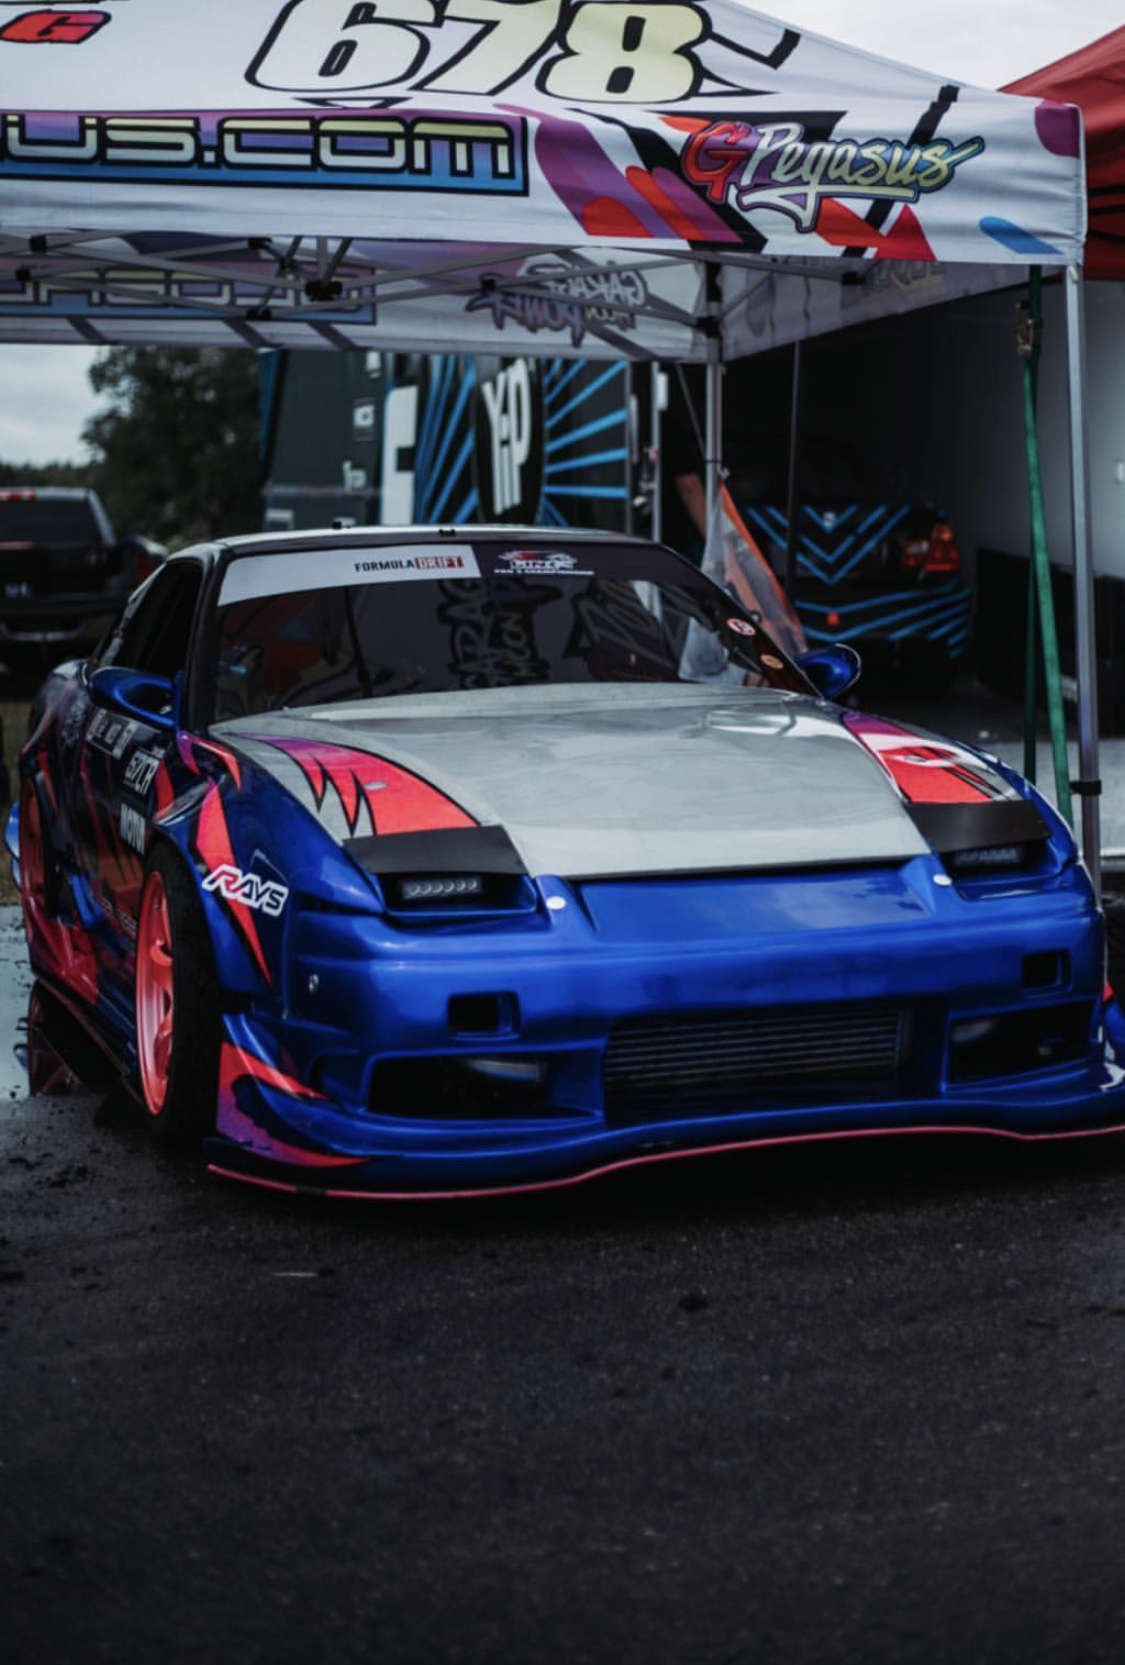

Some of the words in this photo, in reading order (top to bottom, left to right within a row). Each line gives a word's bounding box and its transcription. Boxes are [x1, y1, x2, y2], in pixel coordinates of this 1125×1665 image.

[246, 0, 712, 103] 678
[354, 559, 415, 573] FORMULA
[415, 555, 465, 570] DRIFT
[201, 863, 290, 917] RAYS
